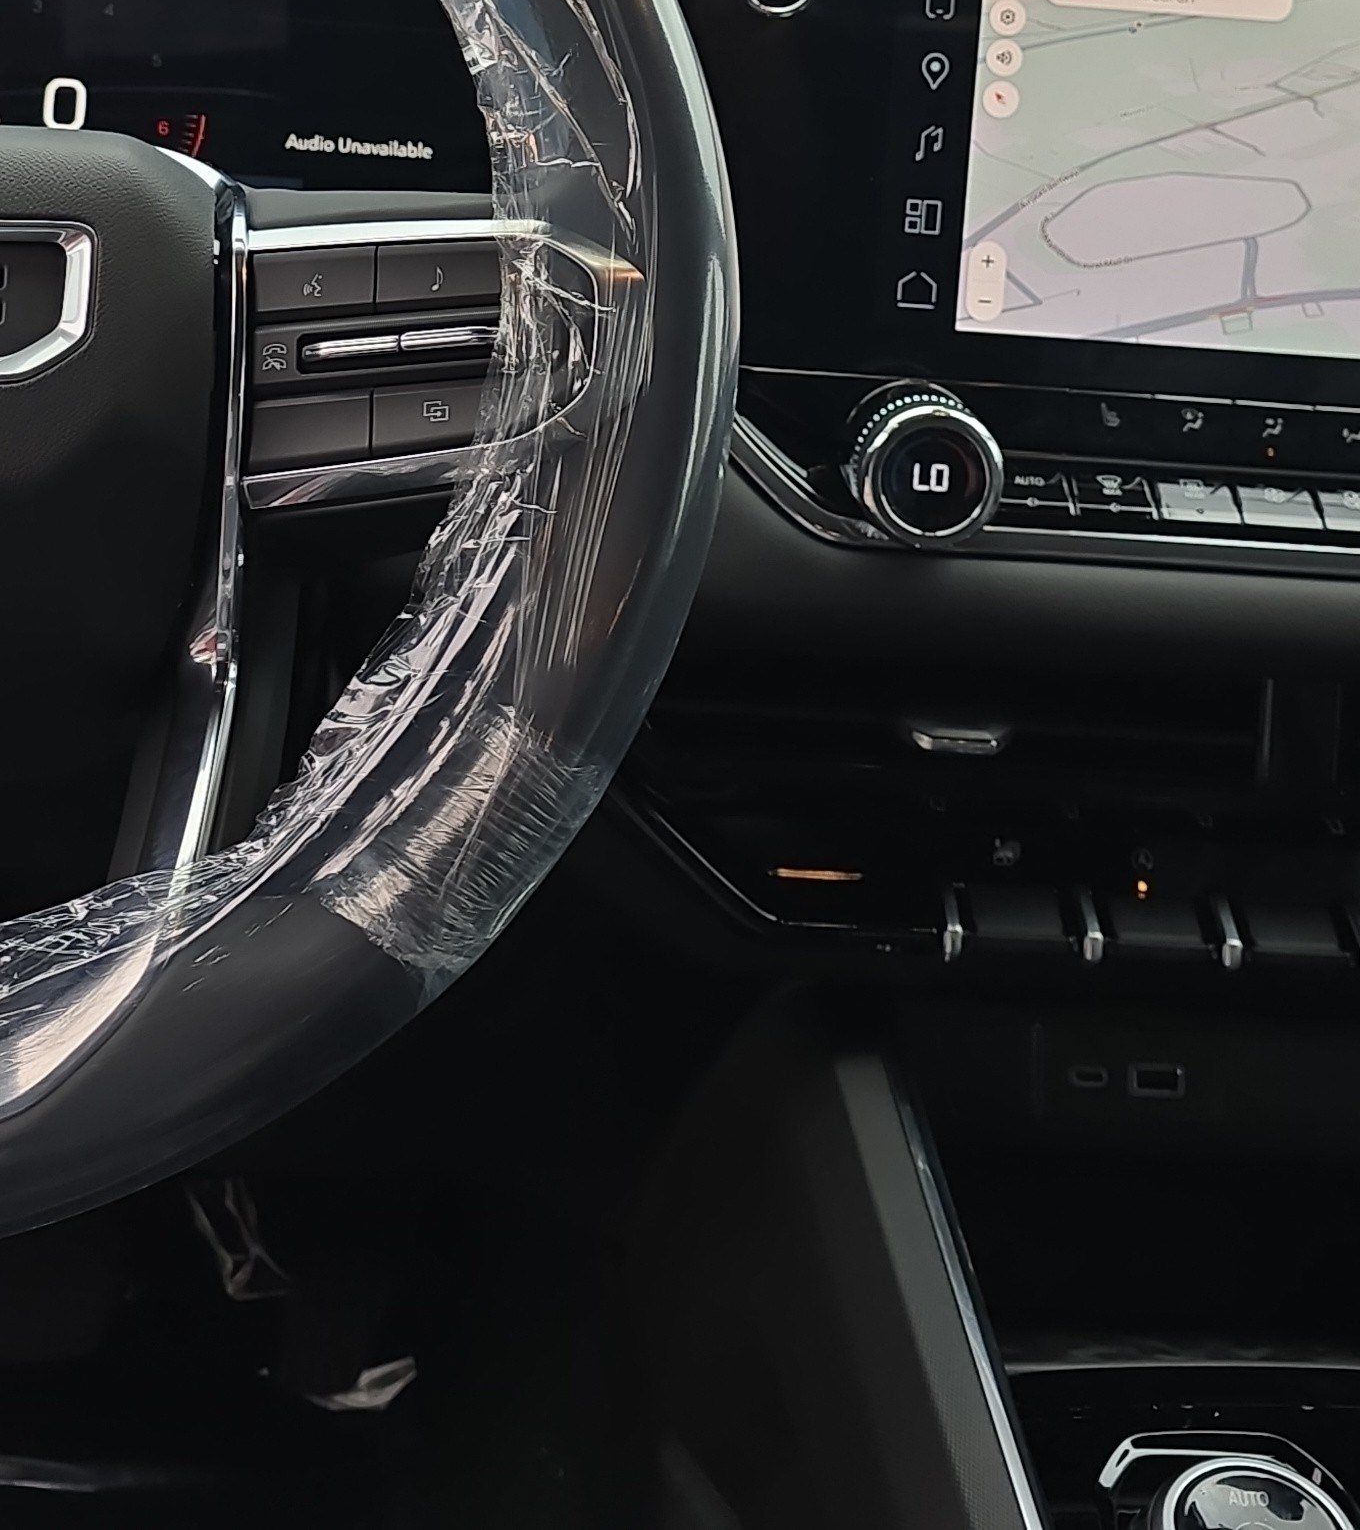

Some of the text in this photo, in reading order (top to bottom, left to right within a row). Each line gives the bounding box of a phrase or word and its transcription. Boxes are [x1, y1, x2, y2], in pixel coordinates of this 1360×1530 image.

[43, 77, 87, 130] 0
[285, 133, 434, 160] Audio Unavailable
[913, 463, 950, 492] LO
[1014, 475, 1046, 487] AUTO
[1229, 1491, 1269, 1507] AUTO
